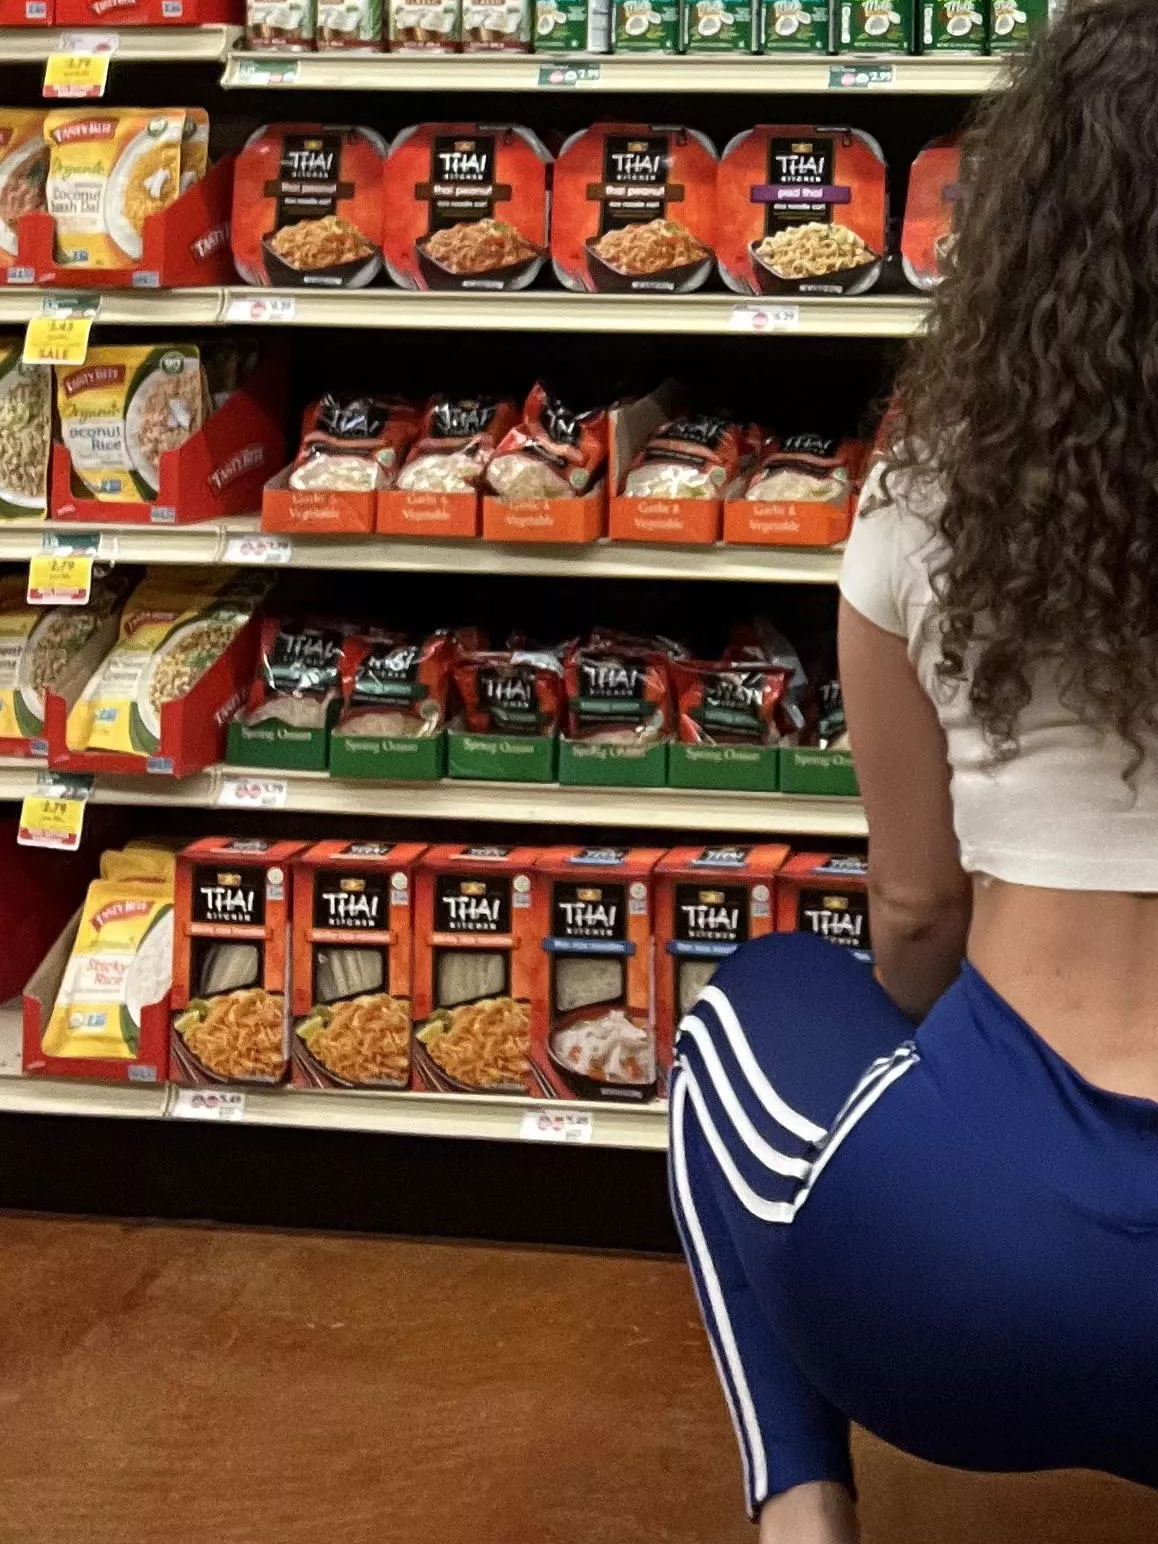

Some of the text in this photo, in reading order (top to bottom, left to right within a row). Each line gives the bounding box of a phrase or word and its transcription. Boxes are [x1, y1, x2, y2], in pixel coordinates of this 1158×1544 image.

[289, 151, 333, 171] THAI
[439, 153, 487, 172] THAI
[612, 154, 660, 175] THAI
[775, 155, 825, 175] THAI
[70, 427, 121, 440] oconut
[582, 666, 638, 688] THAI
[201, 887, 254, 912] THAI
[322, 892, 378, 917] THAI
[442, 897, 500, 919] THAI
[559, 902, 616, 926] THAI
[682, 905, 739, 930] THAI
[804, 910, 863, 935] THAI
